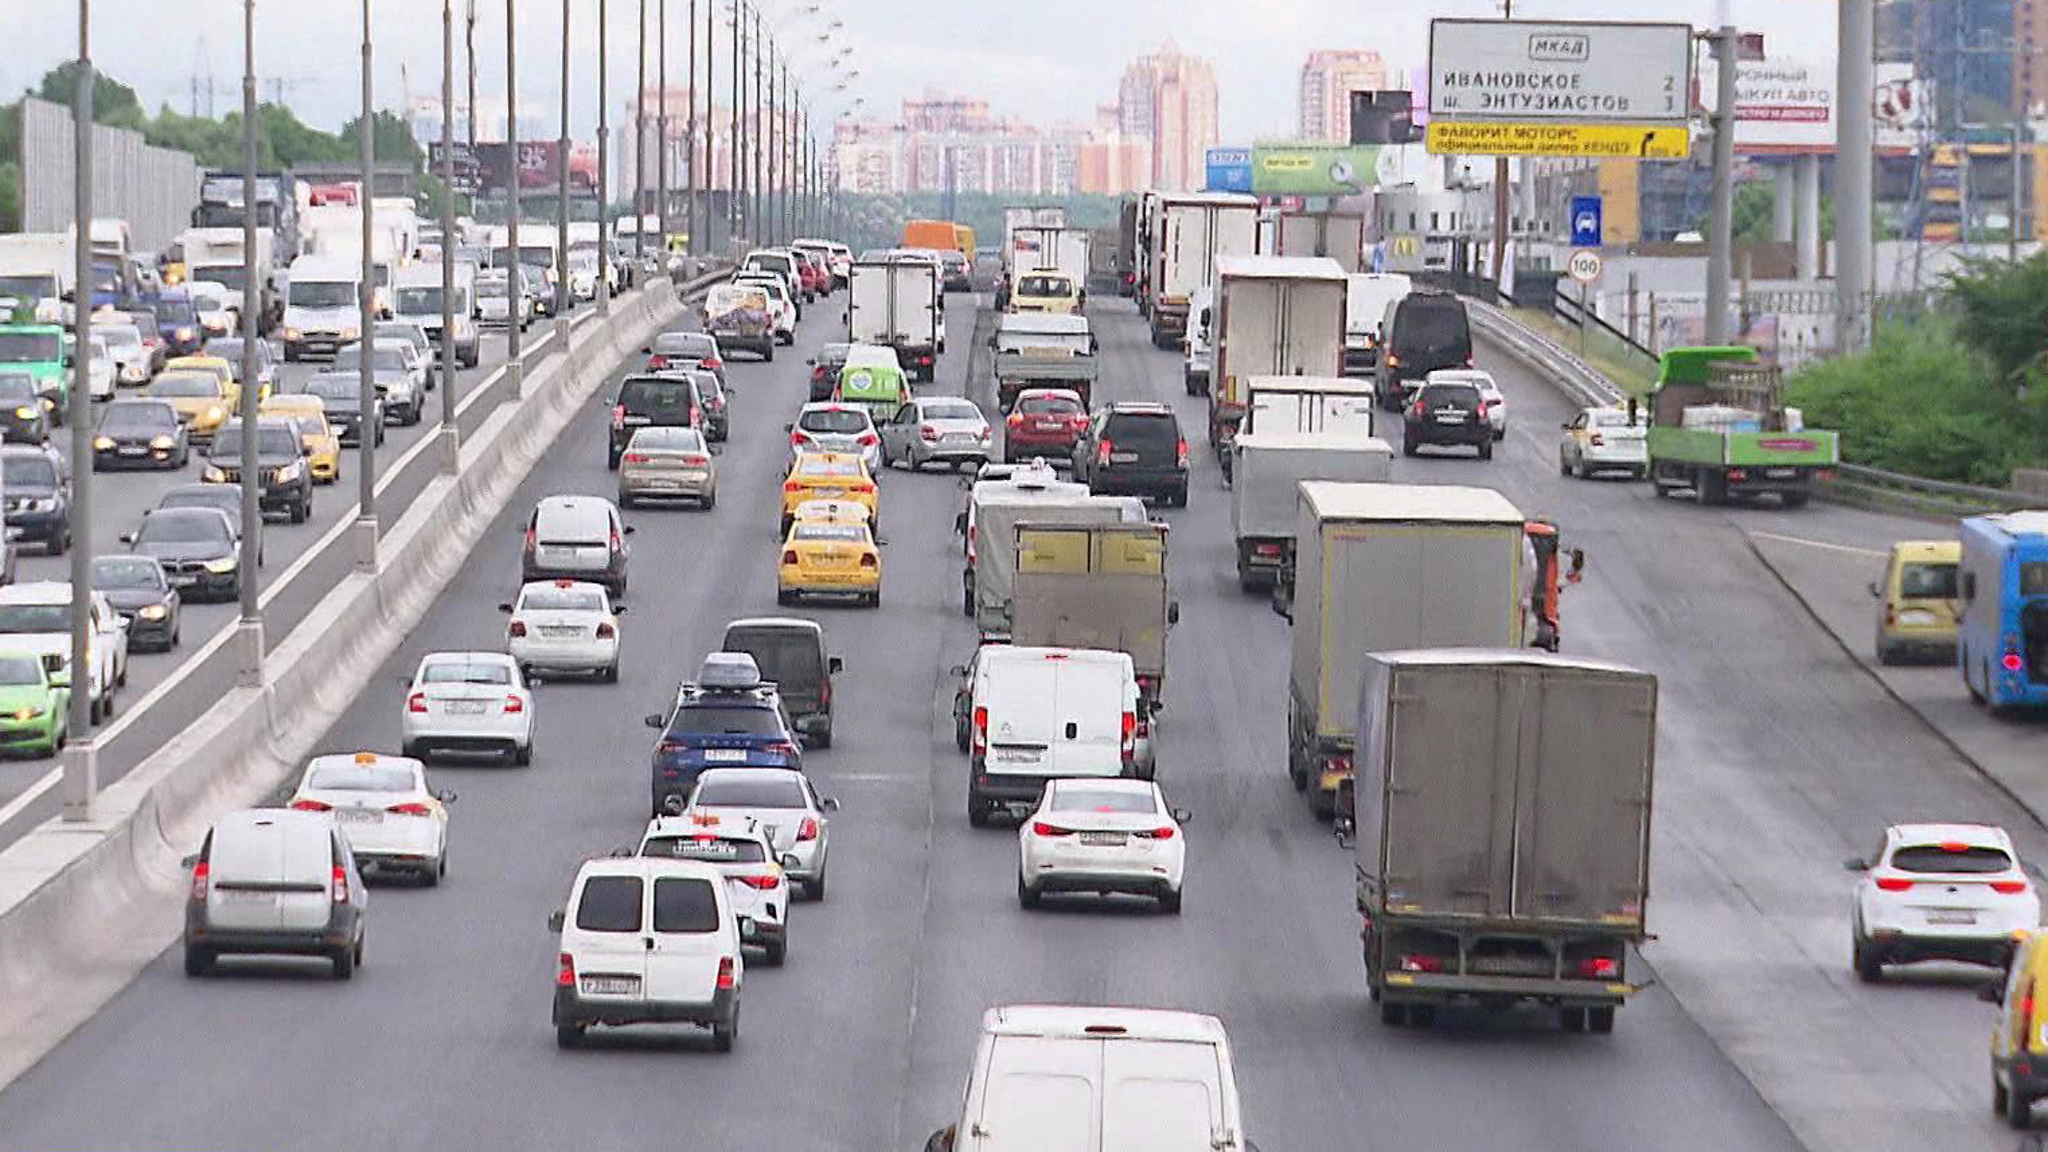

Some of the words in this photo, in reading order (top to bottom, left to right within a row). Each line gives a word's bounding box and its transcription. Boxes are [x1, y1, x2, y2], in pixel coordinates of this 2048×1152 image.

[1533, 40, 1584, 54] МКАД
[1443, 72, 1581, 90] ИВАНОВСКОЕ
[1663, 76, 1674, 91] 2
[1480, 92, 1630, 111] ЭНТУЗИАСТОВ
[1437, 127, 1509, 139] ФАВОРИТ
[1515, 127, 1577, 140] МОТОРС
[1574, 260, 1597, 274] 100
